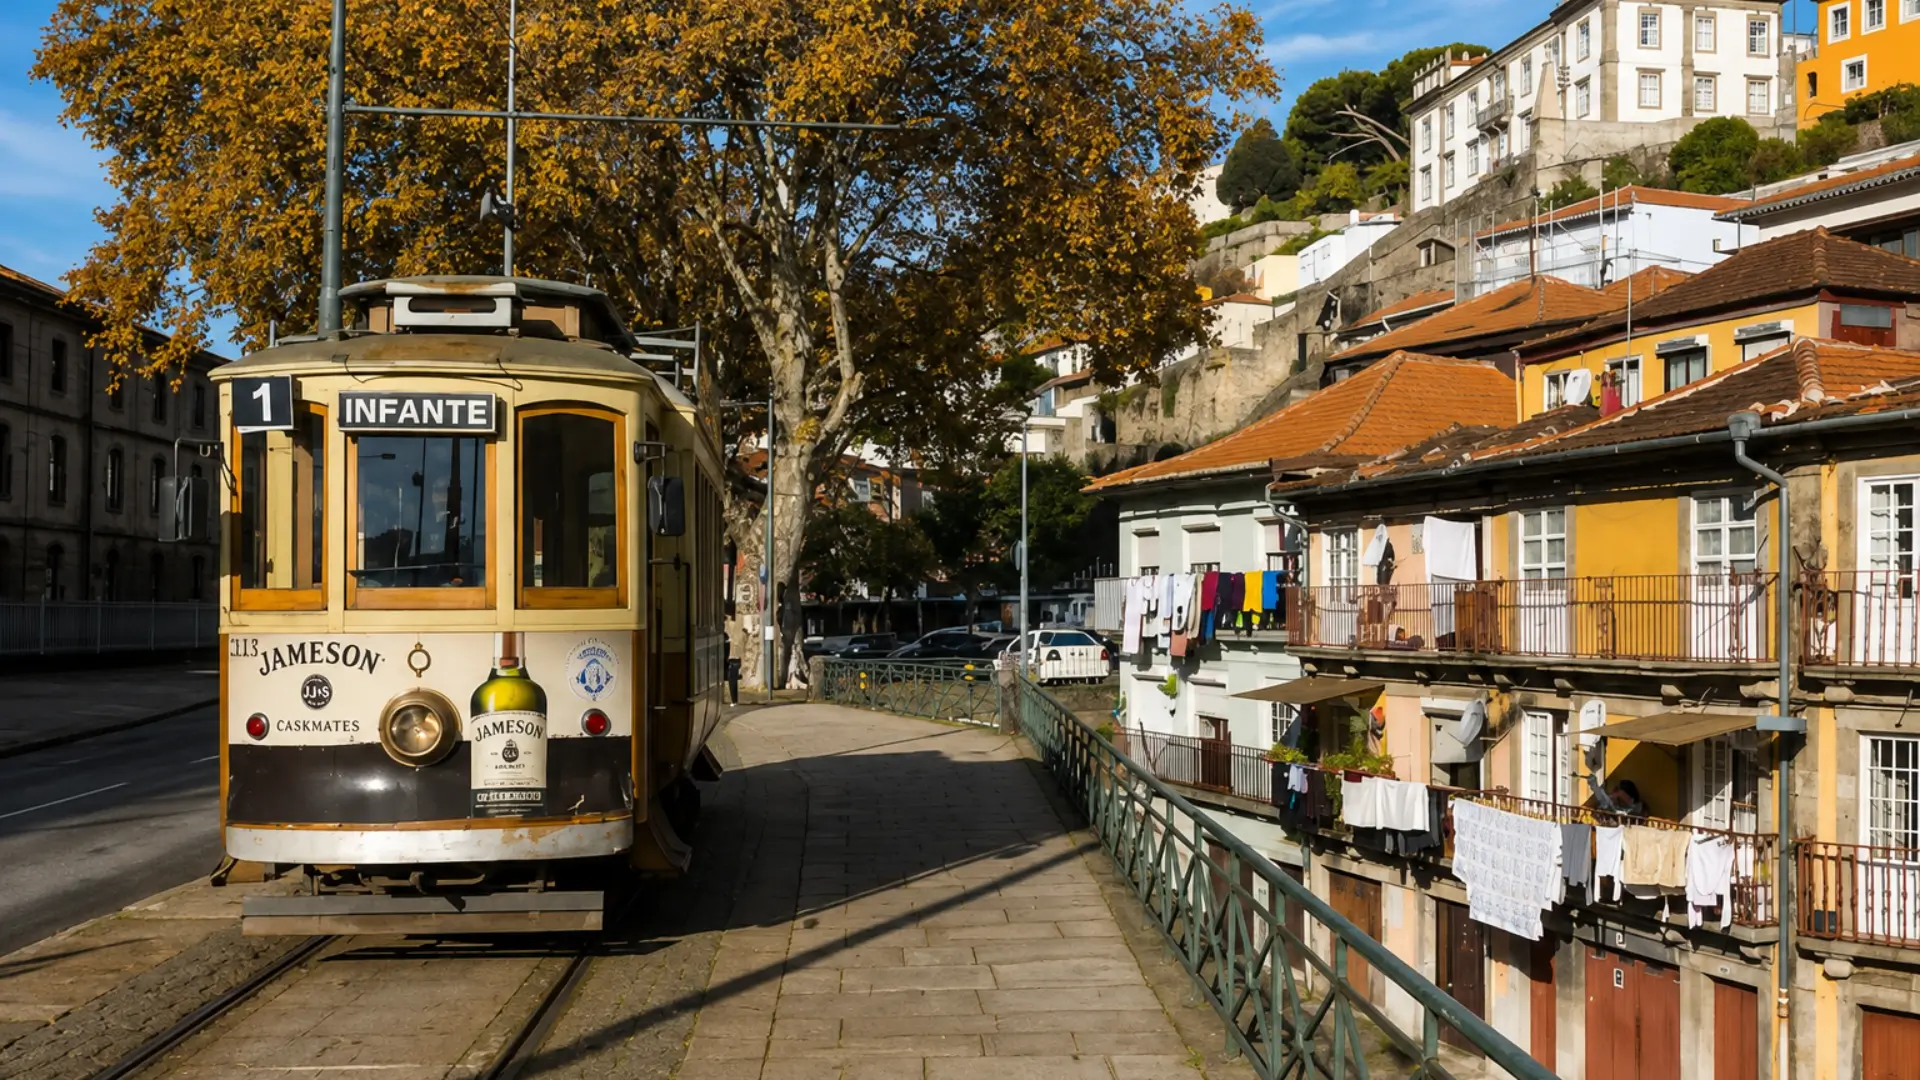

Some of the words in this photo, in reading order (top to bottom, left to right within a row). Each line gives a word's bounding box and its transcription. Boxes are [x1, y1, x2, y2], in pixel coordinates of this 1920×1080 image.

[252, 382, 271, 421] 1
[345, 398, 487, 424] INFANTE
[259, 641, 381, 676] JAMESON
[276, 720, 360, 732] CASKMATES
[475, 720, 544, 742] JAMESON
